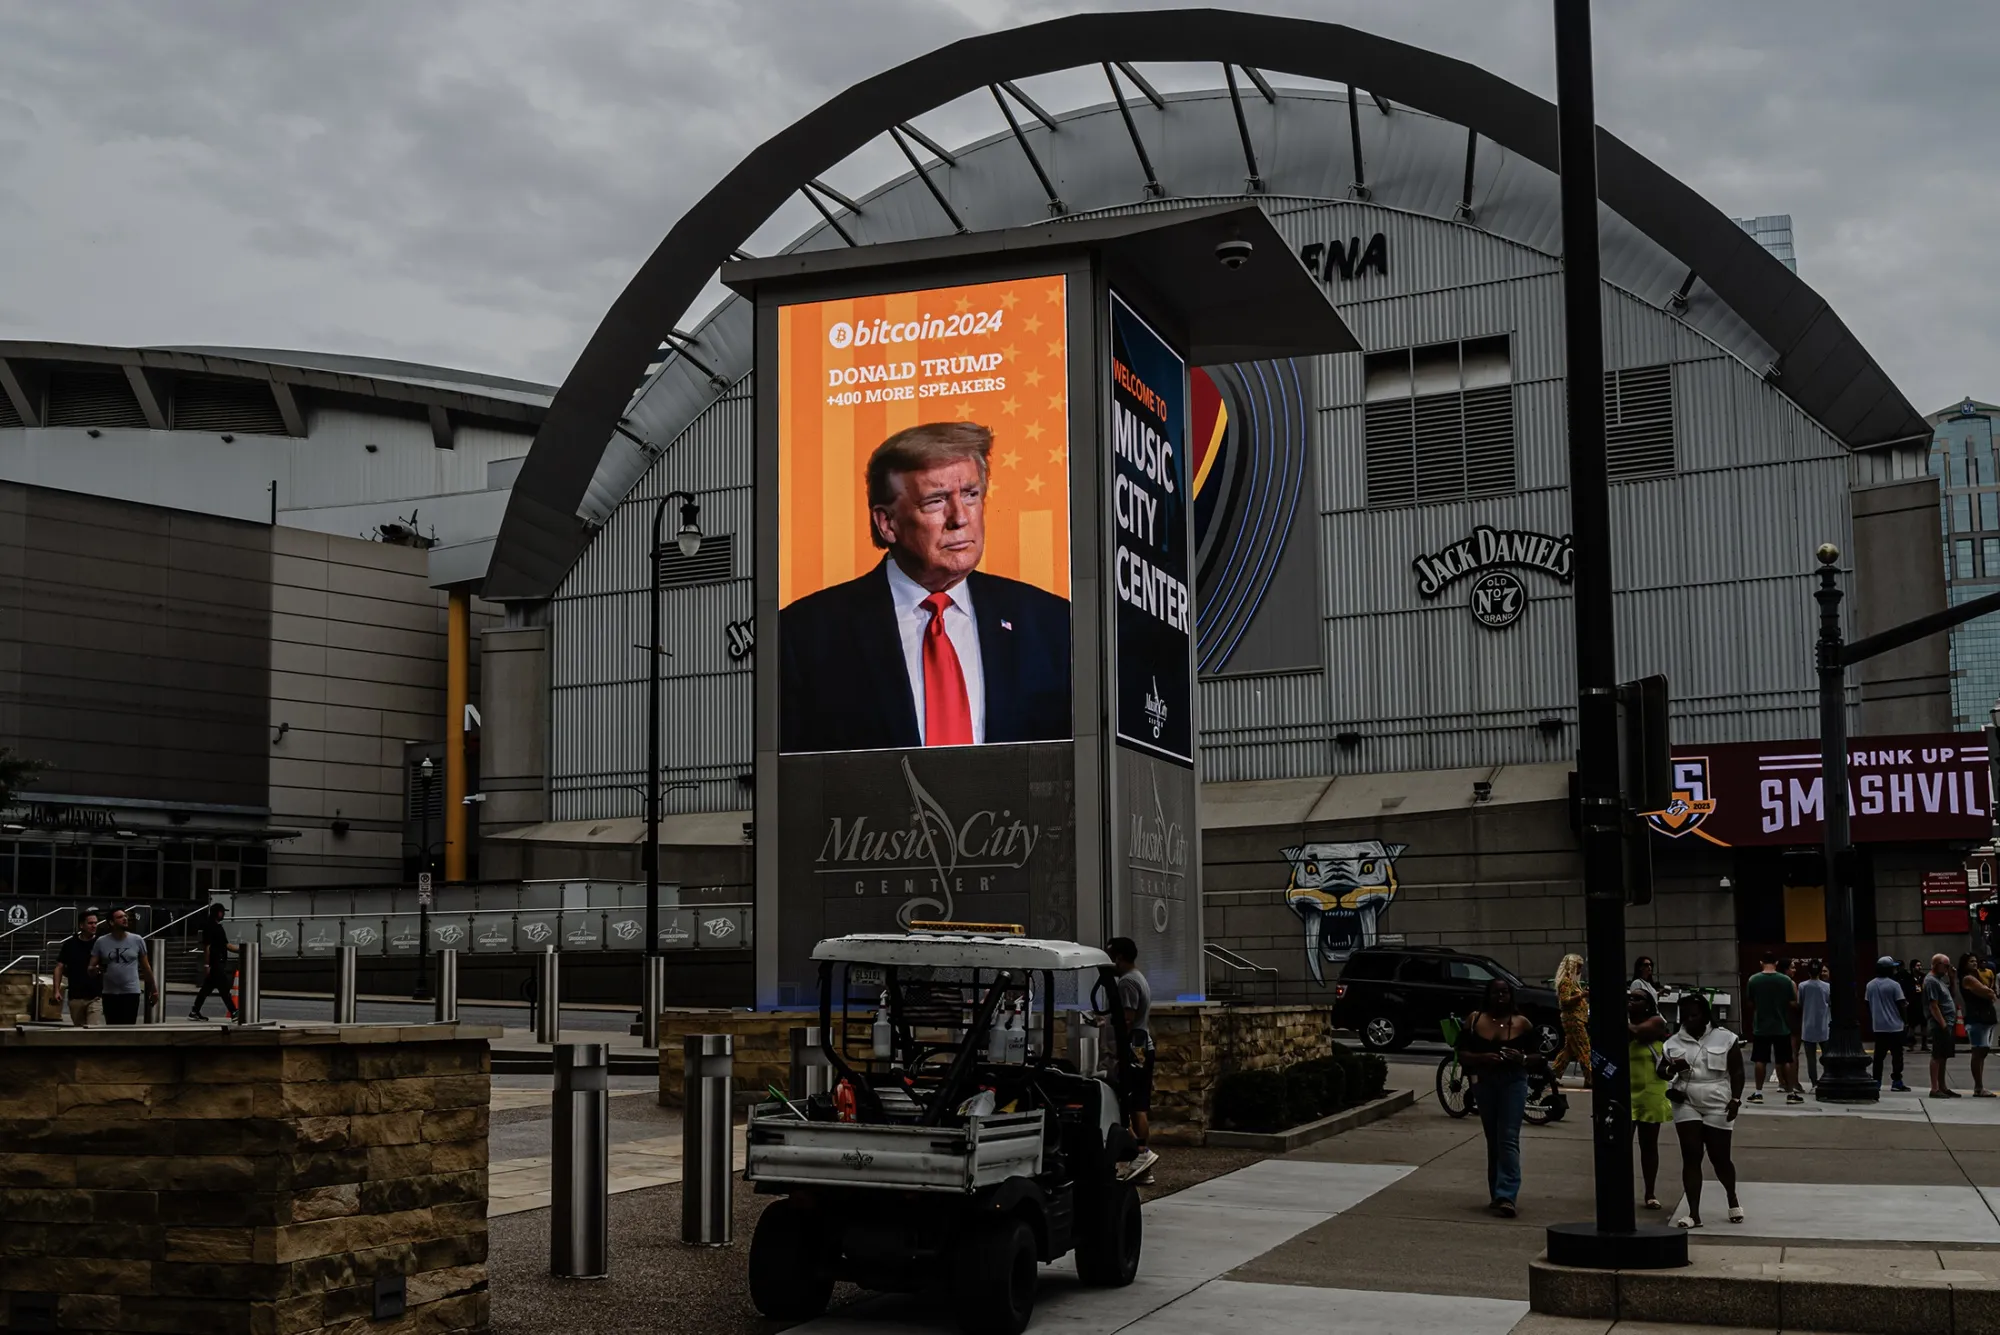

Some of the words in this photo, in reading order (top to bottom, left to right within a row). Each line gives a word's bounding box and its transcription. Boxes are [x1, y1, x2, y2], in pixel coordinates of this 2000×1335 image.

[854, 310, 1003, 346] bitcoin2024
[829, 362, 916, 387] DONALD
[920, 353, 1003, 377] TRUMP
[827, 391, 862, 406] +400
[865, 386, 914, 403] MORE
[919, 377, 1006, 398] SPEAKERS
[1113, 357, 1155, 412] WELCOME
[1155, 395, 1167, 422] TO
[1114, 399, 1175, 494] MUSIC
[1116, 473, 1157, 546] CITY
[1417, 541, 1479, 594] JACK
[1477, 529, 1575, 576] DANIEL'S
[1117, 545, 1189, 634] CENTER
[1487, 577, 1507, 586] OLD
[1484, 613, 1513, 624] BRAND
[1846, 750, 1912, 767] RINK
[1922, 748, 1954, 763] UP
[1693, 802, 1711, 810] 2023
[815, 812, 938, 862] Music
[958, 809, 1039, 869] City
[855, 876, 991, 895] CENTER
